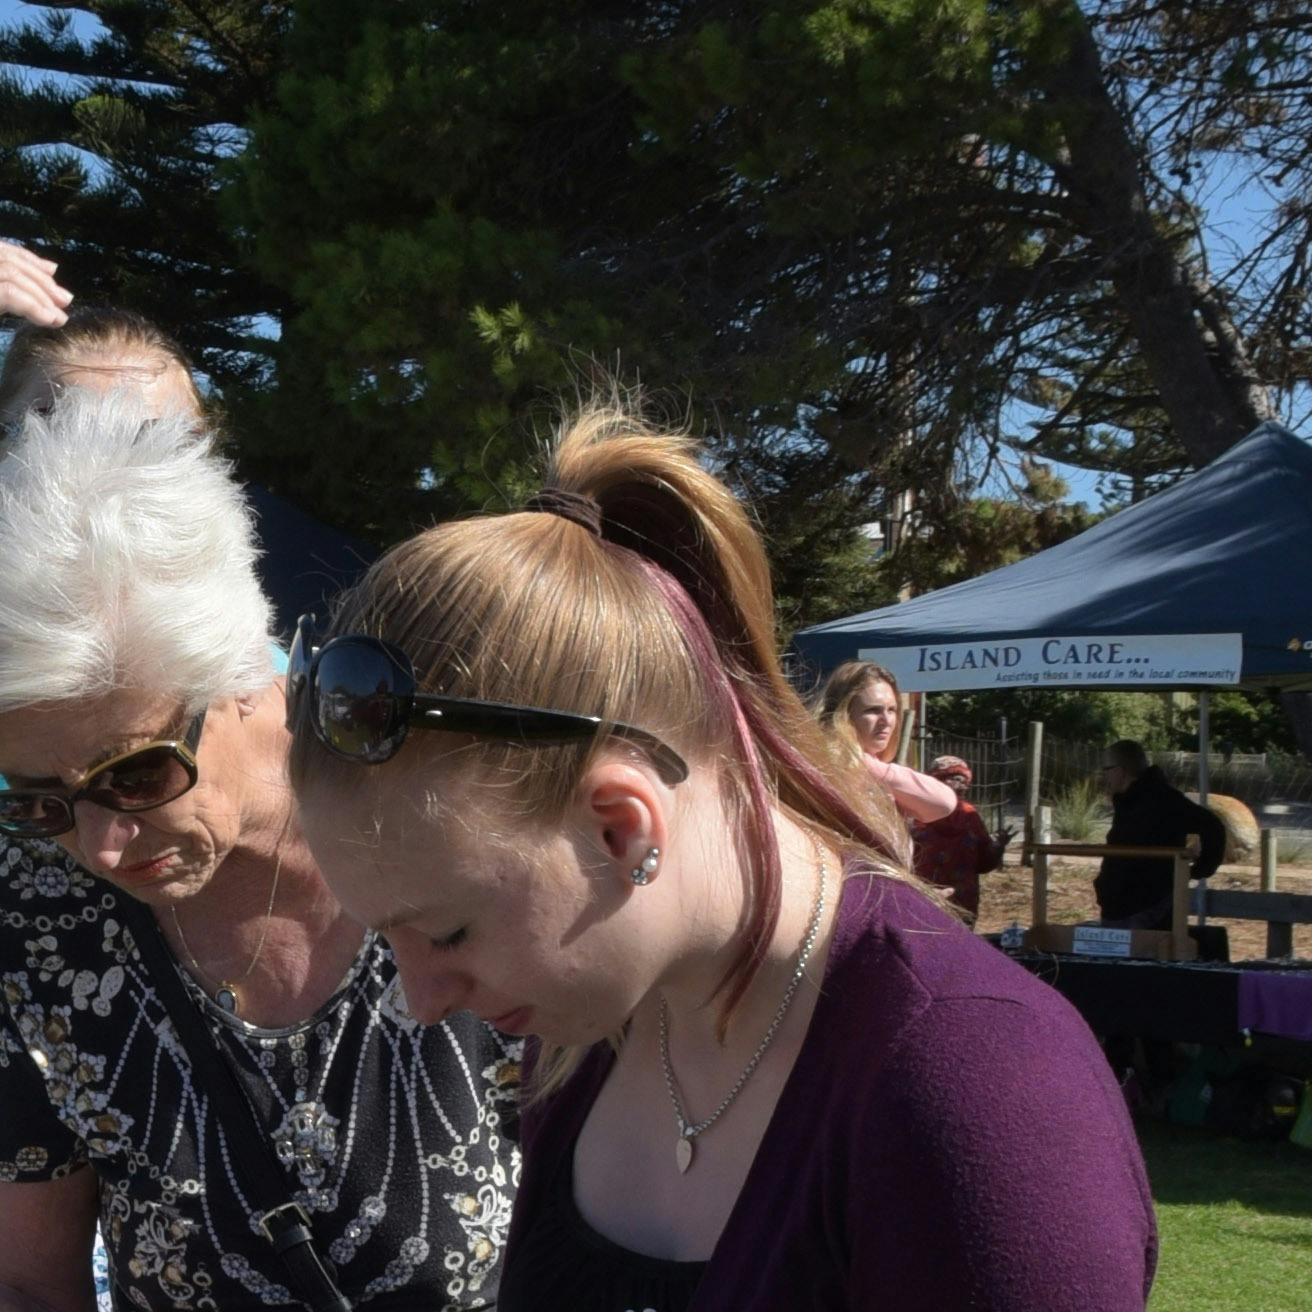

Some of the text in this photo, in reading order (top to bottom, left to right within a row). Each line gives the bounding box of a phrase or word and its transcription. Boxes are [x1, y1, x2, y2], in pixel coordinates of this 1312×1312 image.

[917, 647, 1022, 672] ISLAND
[996, 668, 1237, 683] Assisting those in need in the local community
